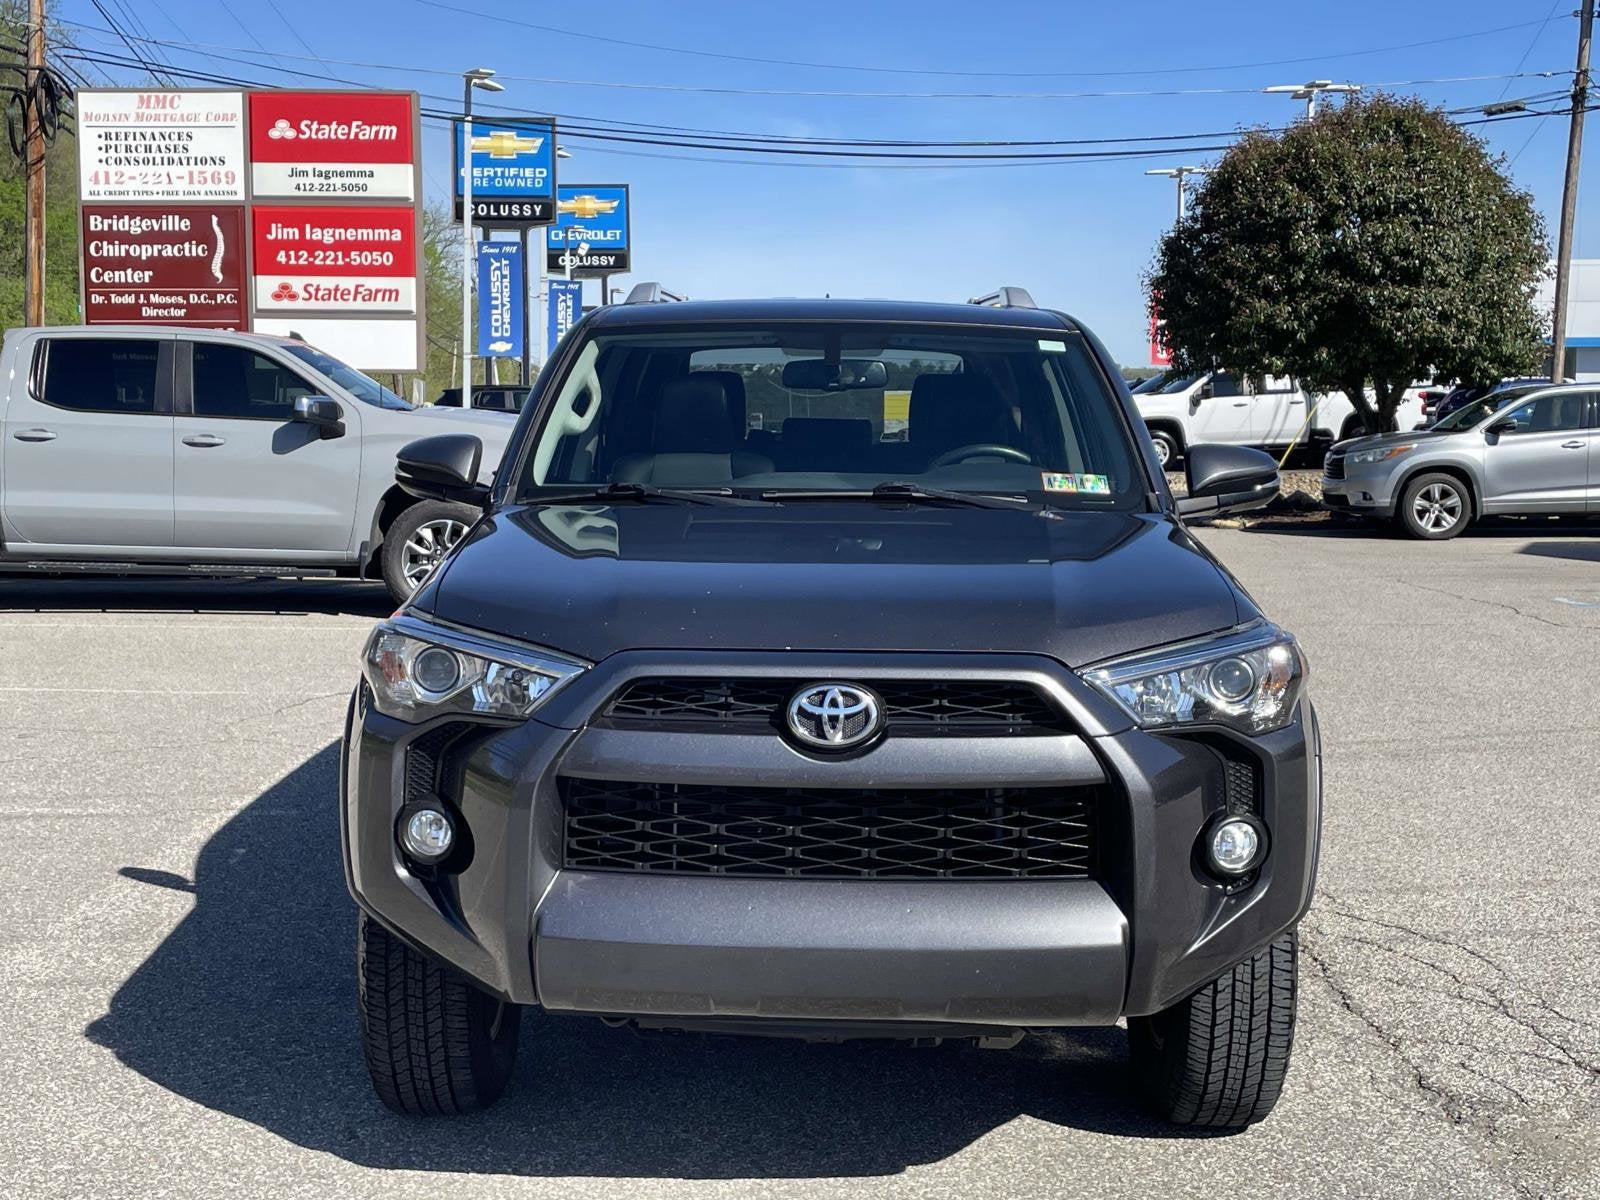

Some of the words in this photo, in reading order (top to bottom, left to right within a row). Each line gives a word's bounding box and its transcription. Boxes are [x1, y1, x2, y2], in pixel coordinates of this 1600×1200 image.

[136, 94, 182, 109] MMC
[133, 112, 201, 122] MORTGAGE
[103, 131, 194, 141] REFINANCES
[104, 143, 190, 154] PURCHASES
[104, 156, 226, 166] CONSOLIDATIONS
[88, 170, 236, 186] 412-221-1569
[287, 167, 309, 178] Jim
[312, 167, 374, 180] Iagnemma
[294, 183, 369, 193] 412-221-5050
[89, 214, 191, 235] Bridgeville
[266, 223, 299, 240] Jim
[305, 223, 402, 244] Iagnemma
[89, 240, 208, 261] Chiropractic
[276, 250, 394, 266] 412-221-5050
[89, 266, 154, 283] Center
[91, 293, 107, 304] Dr.
[110, 293, 135, 304] Todd
[138, 293, 147, 304] J.
[149, 293, 187, 305] Moses,
[189, 293, 215, 305] D.C.,
[216, 293, 238, 304] P.C.
[490, 257, 502, 337] COLUSSY
[502, 257, 511, 337] CHEVROLET
[141, 306, 187, 317] Director
